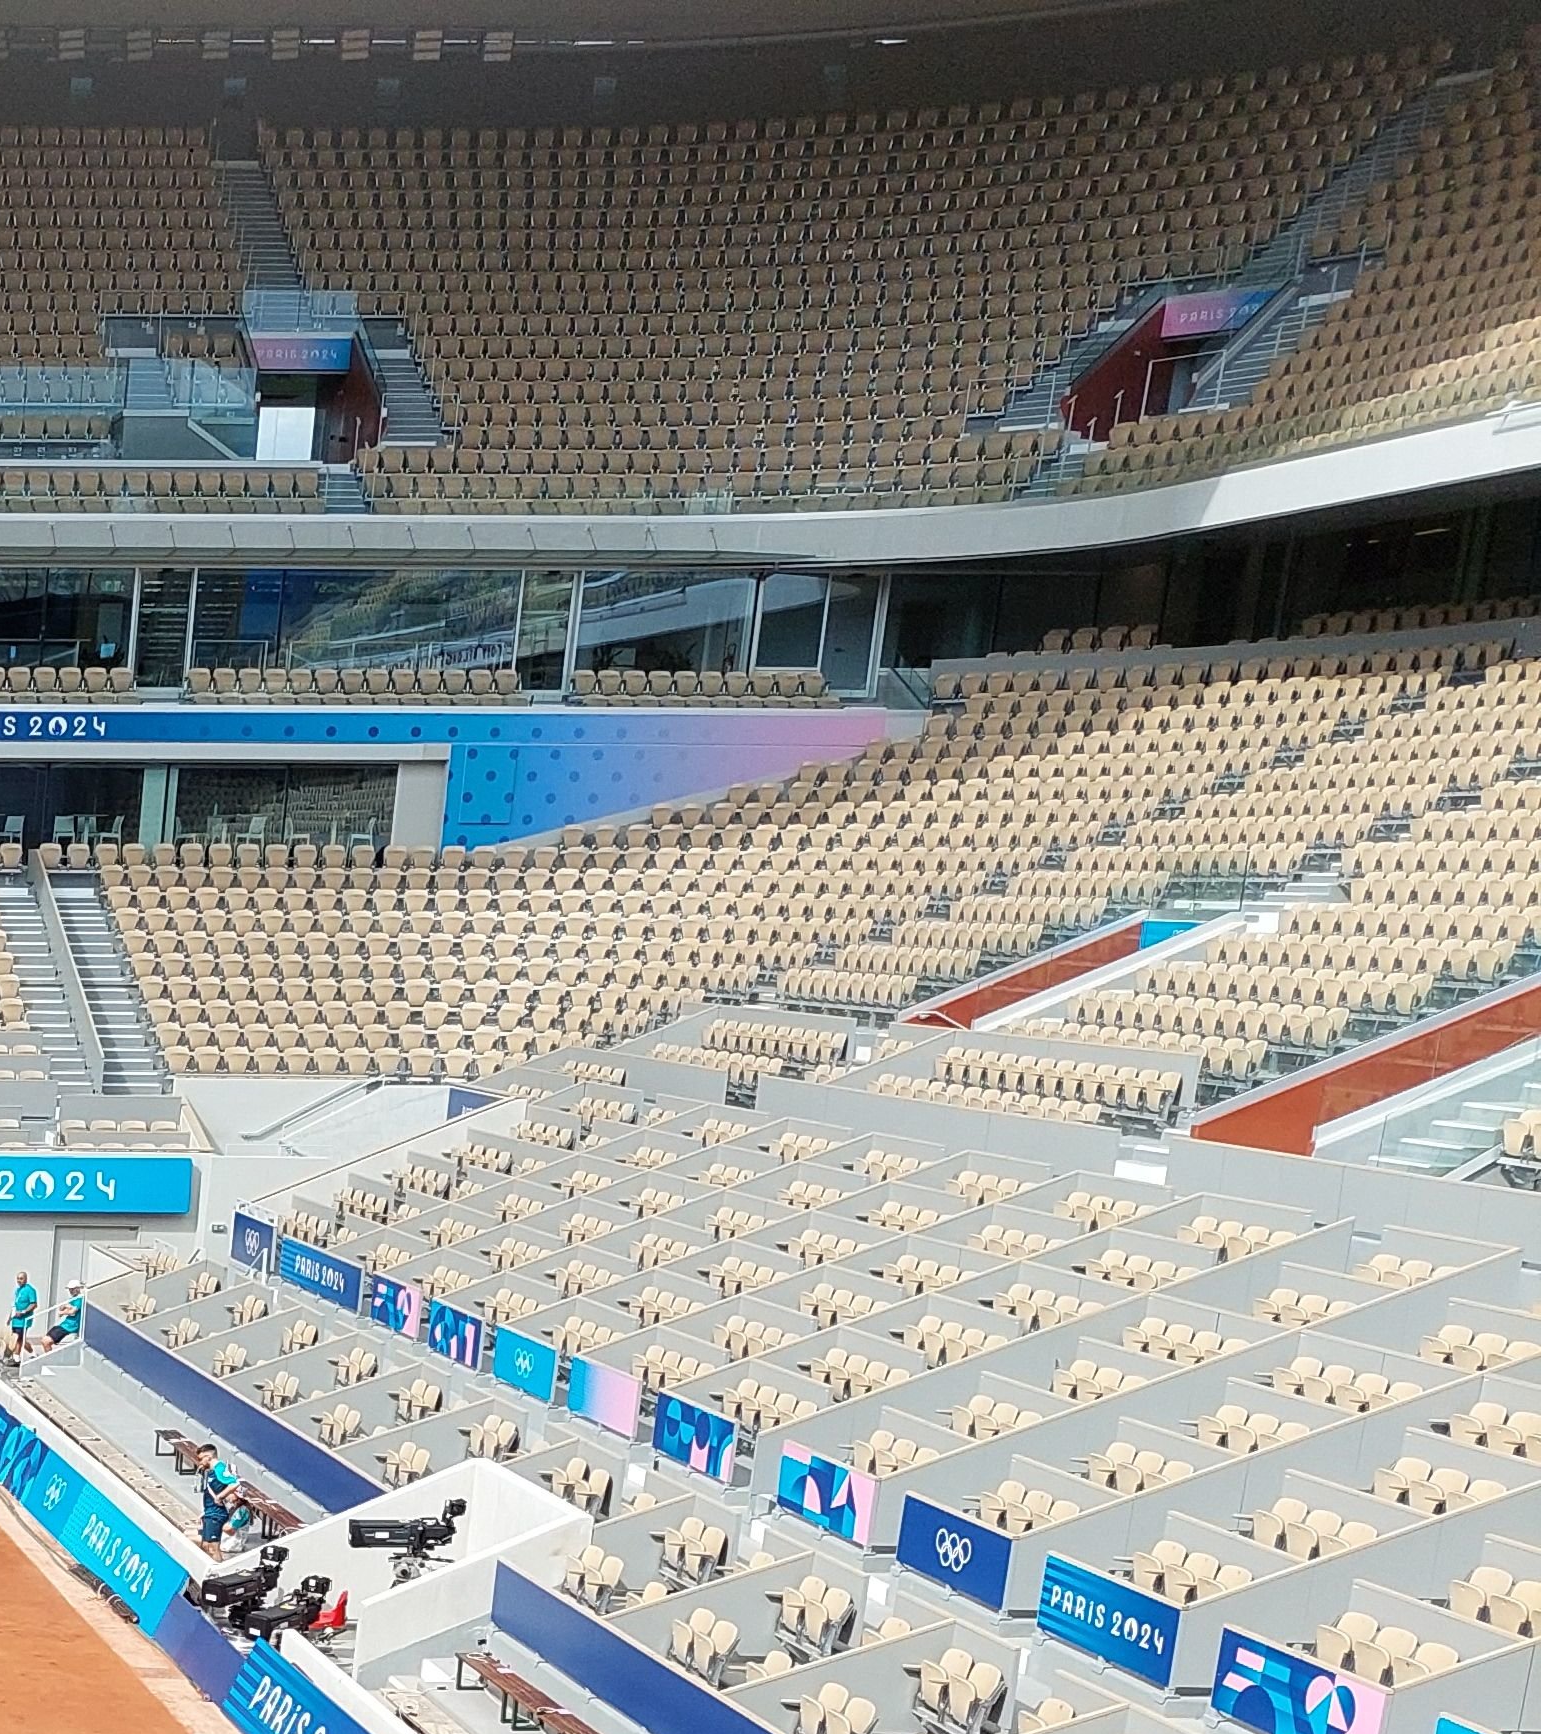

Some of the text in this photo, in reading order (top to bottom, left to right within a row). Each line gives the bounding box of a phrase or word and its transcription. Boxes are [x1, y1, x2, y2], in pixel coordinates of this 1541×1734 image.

[29, 716, 106, 736] 2024
[293, 1254, 345, 1295] PARIS 2024
[80, 1513, 154, 1600] PARIS 2024
[1050, 1585, 1164, 1655] PARIS 2024
